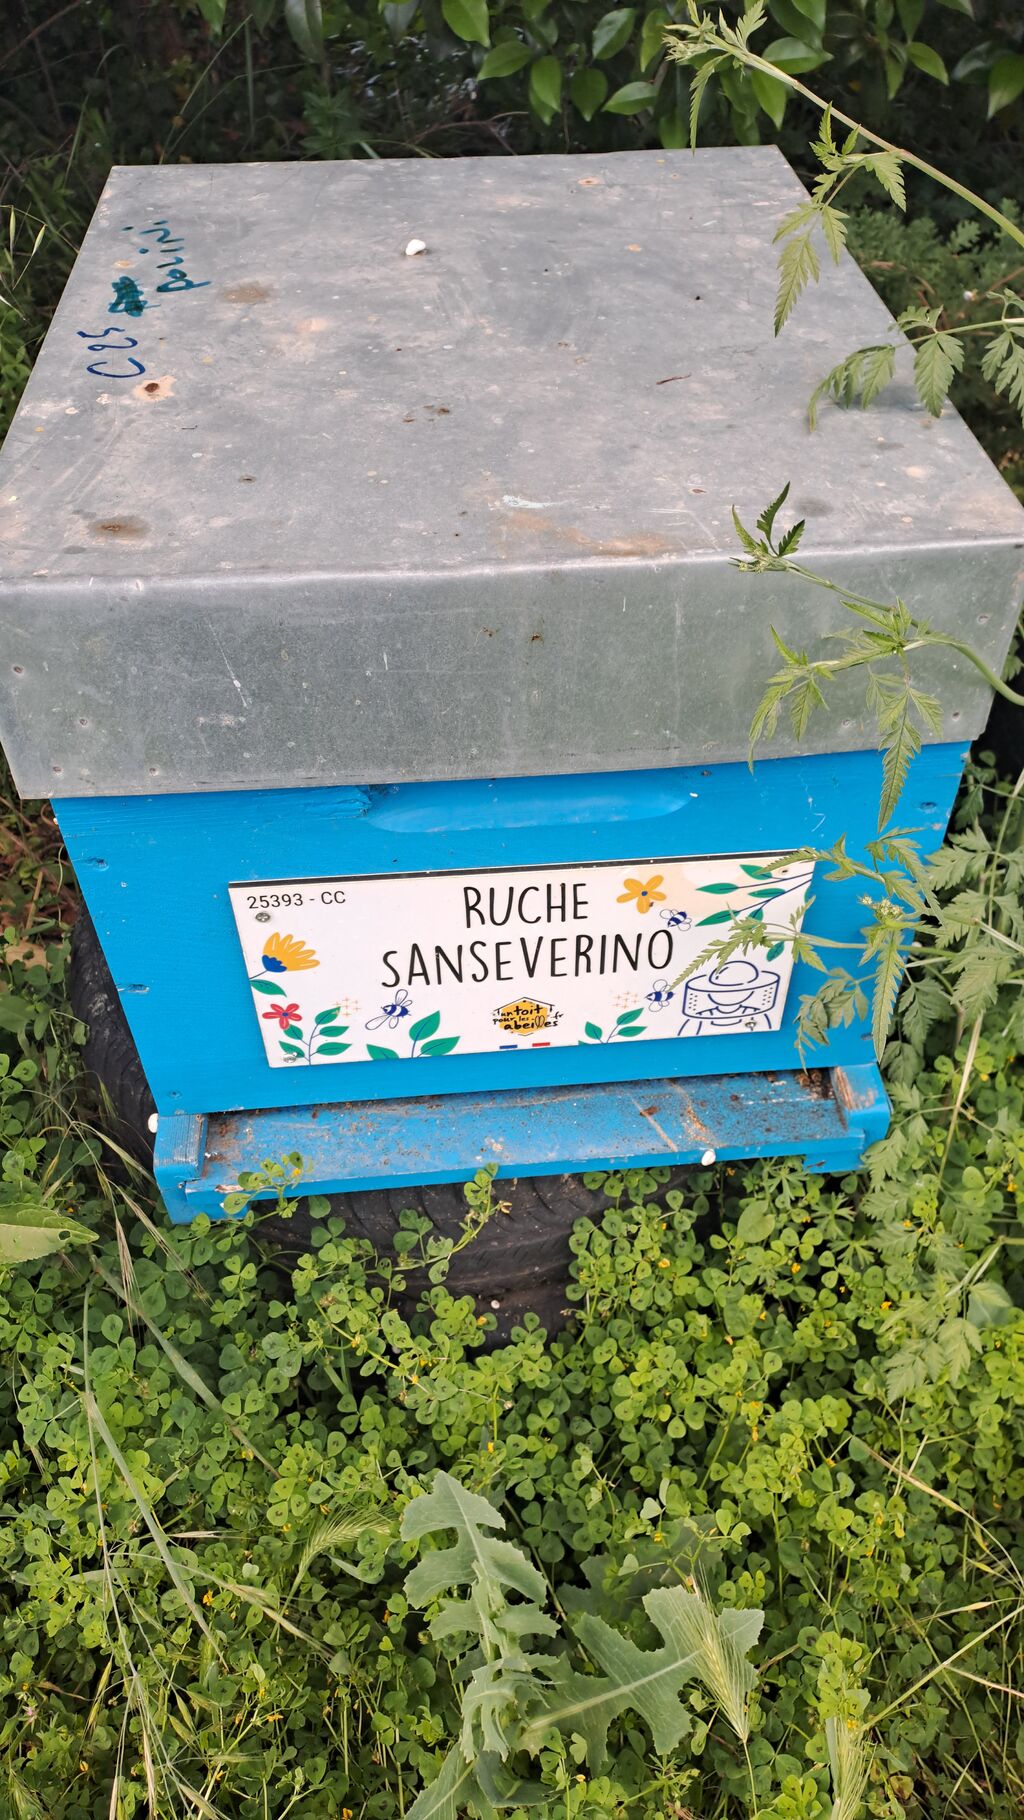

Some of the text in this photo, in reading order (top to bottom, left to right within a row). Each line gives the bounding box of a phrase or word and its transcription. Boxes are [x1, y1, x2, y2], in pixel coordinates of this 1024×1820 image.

[246, 893, 304, 910] 25393
[320, 890, 347, 905] CC
[463, 882, 588, 929] RUCHE
[381, 929, 675, 988] SANSEVERINO
[514, 1004, 543, 1015] toit
[492, 1016, 515, 1024] pour
[503, 1015, 558, 1030] abeilles
